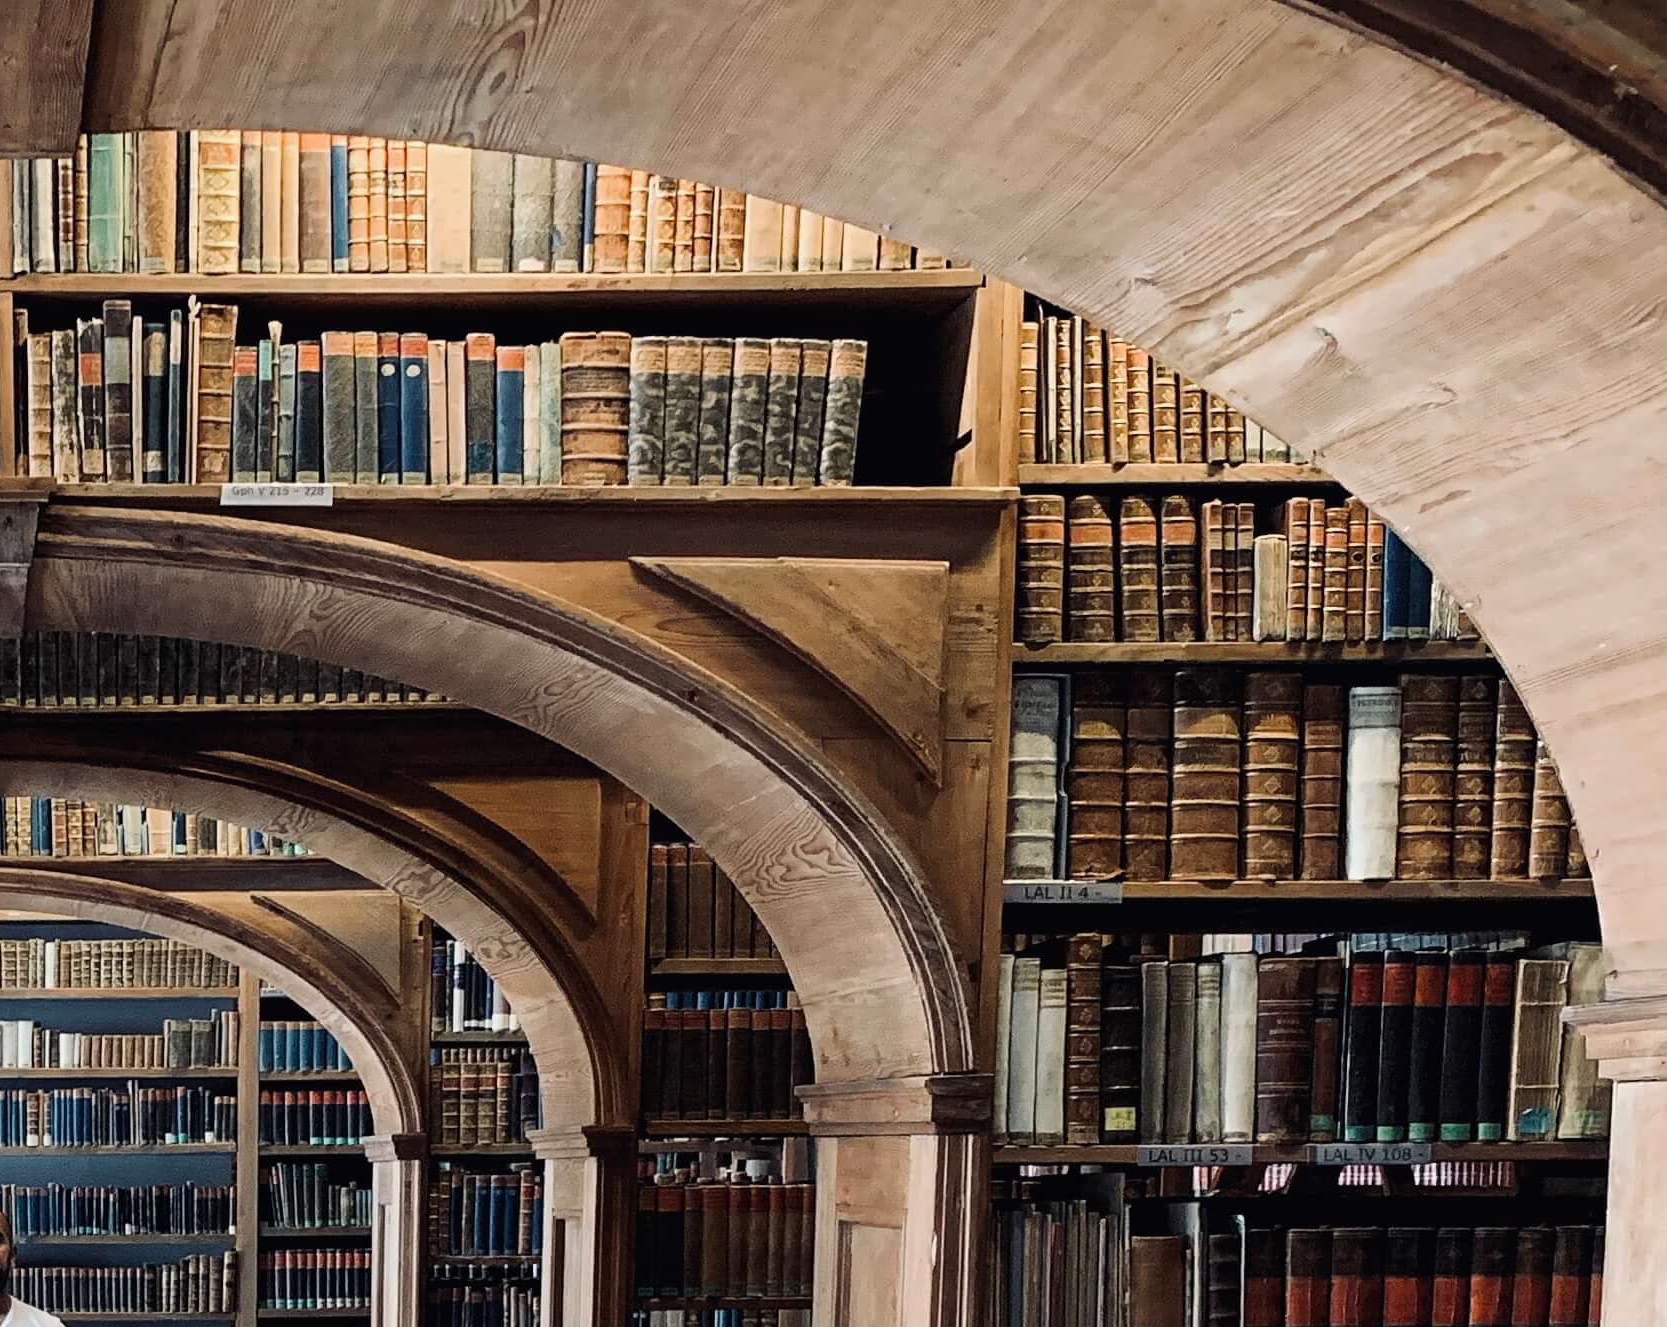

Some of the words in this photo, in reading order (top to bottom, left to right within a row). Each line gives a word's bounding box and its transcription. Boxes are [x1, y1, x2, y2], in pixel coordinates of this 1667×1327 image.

[258, 486, 266, 496] V
[1024, 886, 1054, 899] LAL
[1060, 886, 1072, 899] II
[1078, 886, 1089, 898] 4
[1149, 1149, 1178, 1162] LAL
[1183, 1149, 1203, 1162] III
[1210, 1148, 1229, 1162] 53
[1324, 1148, 1352, 1161] LAL
[1358, 1148, 1376, 1161] IV
[1384, 1147, 1412, 1161] 108
